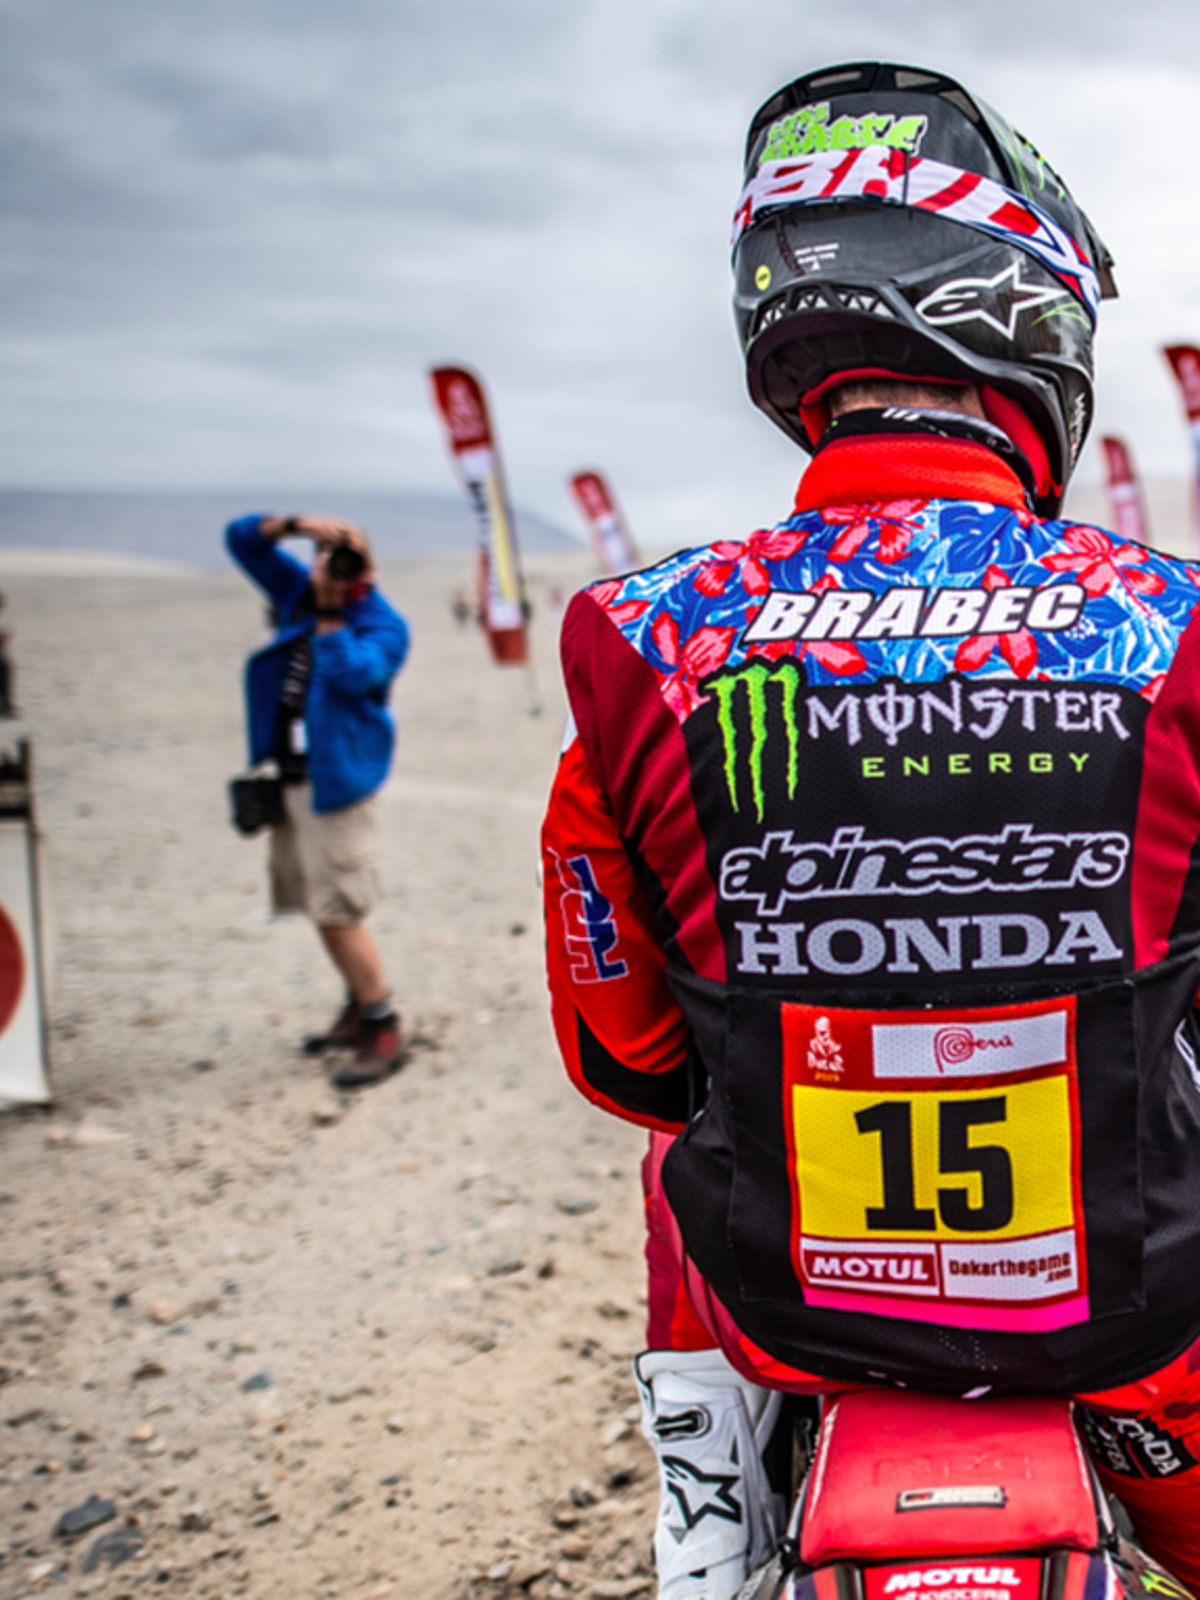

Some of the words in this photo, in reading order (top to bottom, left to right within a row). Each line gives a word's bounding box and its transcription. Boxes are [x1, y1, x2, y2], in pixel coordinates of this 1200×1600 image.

[741, 583, 1085, 643] BRABEC
[805, 680, 1131, 746] MONSTER
[861, 752, 1090, 778] ENERGY
[719, 824, 1130, 916] alpinestars
[734, 911, 1124, 976] HONDA
[854, 1096, 1015, 1232] 15
[812, 1256, 929, 1281] MOTUL
[949, 1252, 1071, 1277] Dakarthegame
[1044, 1268, 1072, 1284] .com
[884, 1567, 1021, 1594] MOTUL
